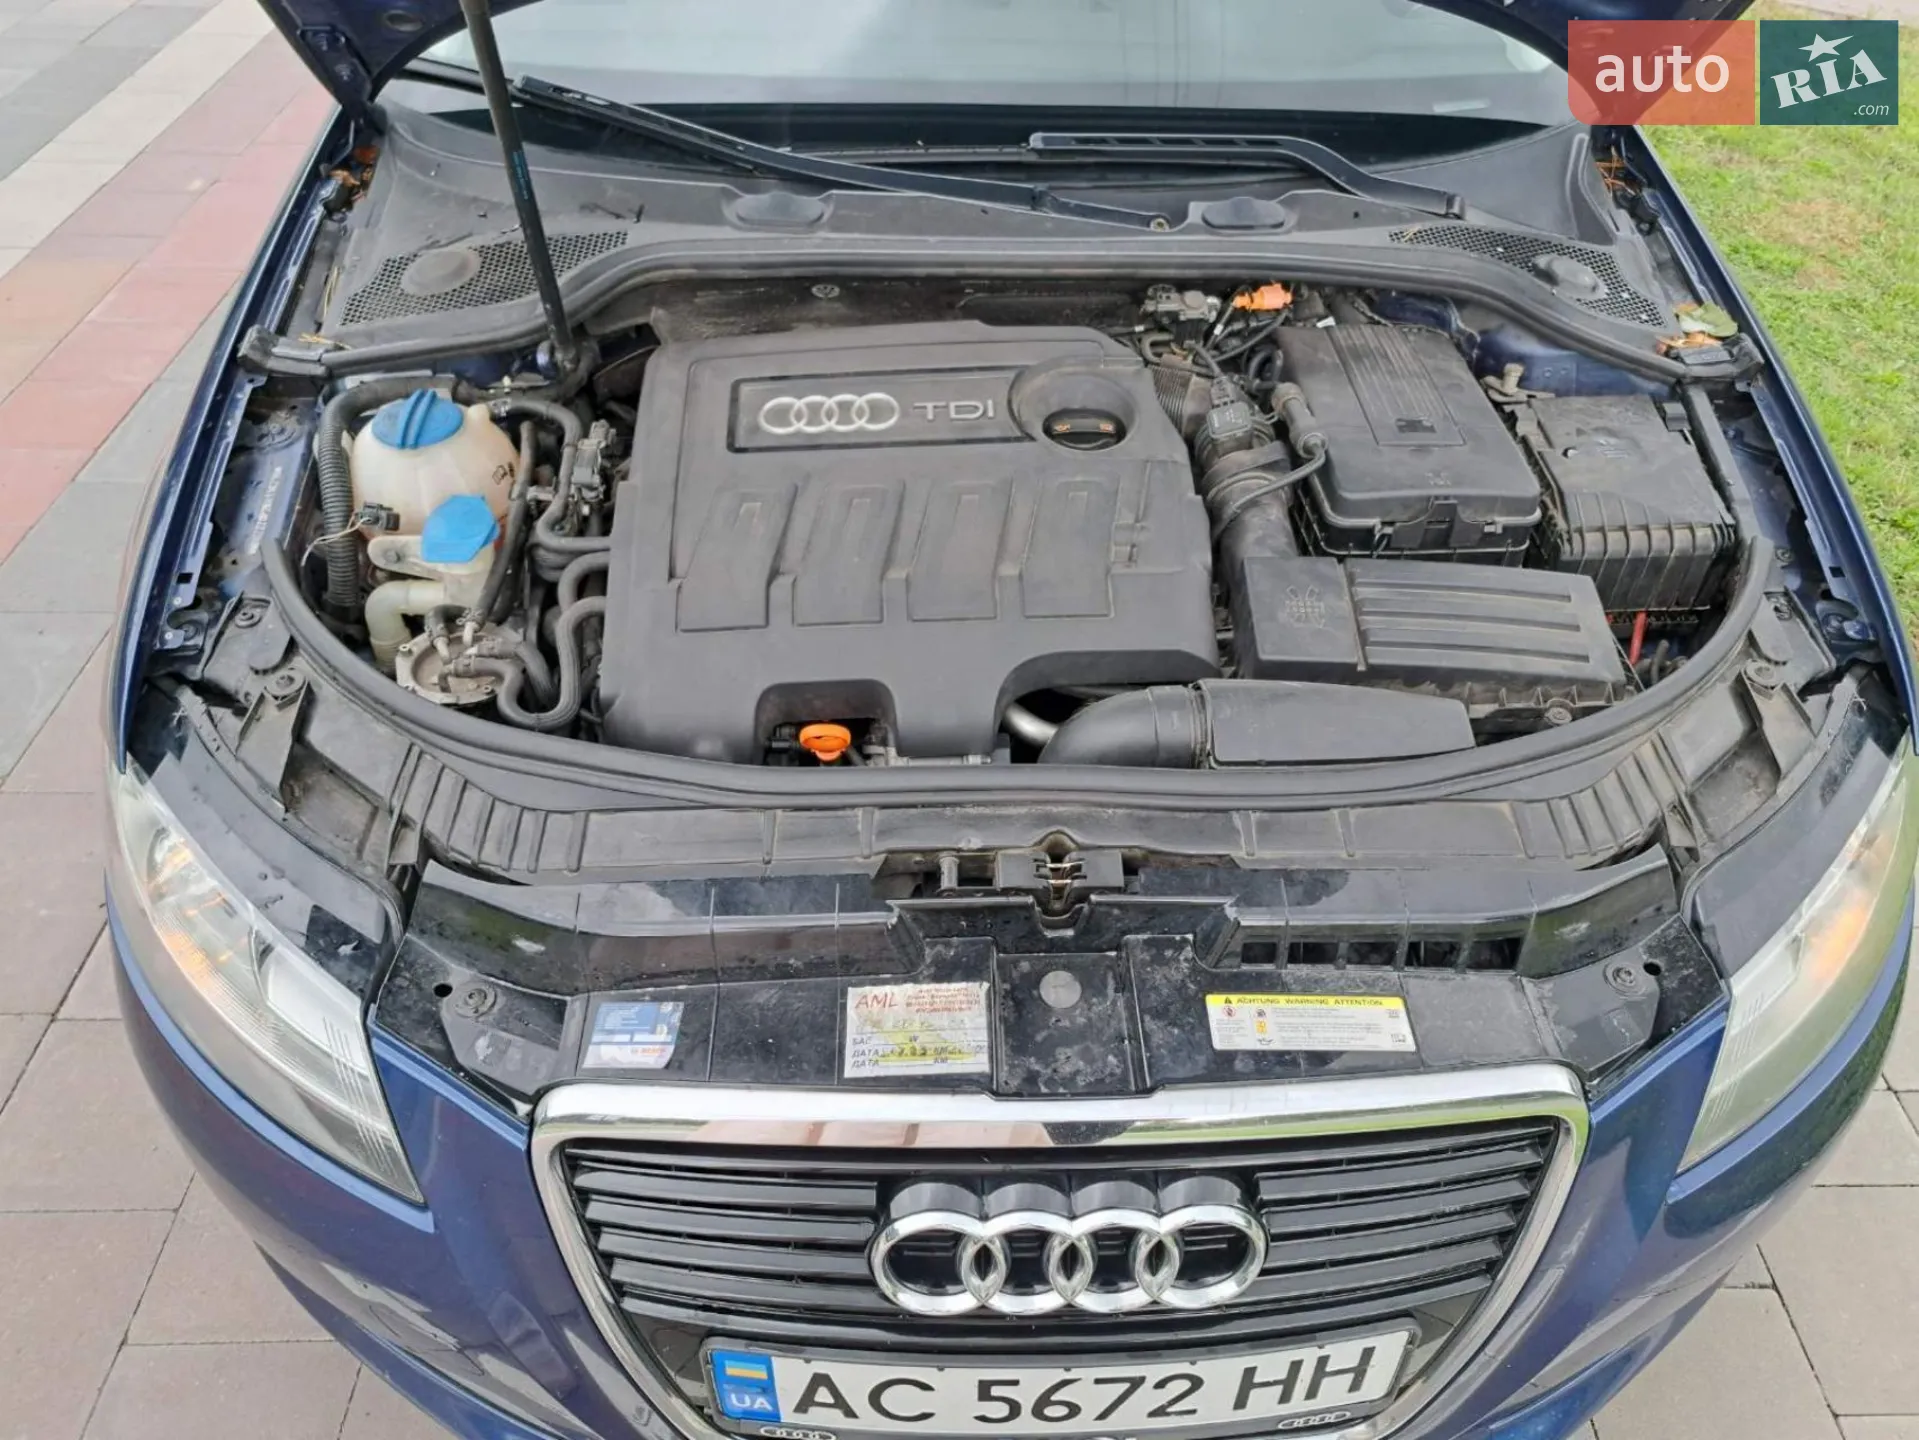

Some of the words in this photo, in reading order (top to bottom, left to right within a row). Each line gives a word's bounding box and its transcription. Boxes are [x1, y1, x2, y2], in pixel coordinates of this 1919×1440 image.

[913, 399, 995, 421] TDI
[855, 991, 899, 1009] AML
[1236, 997, 1281, 1005] ACHTUNG
[1285, 998, 1329, 1006] WARNING
[1334, 998, 1384, 1006] ATTENTION
[793, 1372, 936, 1422] AC
[973, 1373, 1205, 1423] 5672
[1233, 1346, 1376, 1411] HH
[730, 1393, 773, 1411] UA
